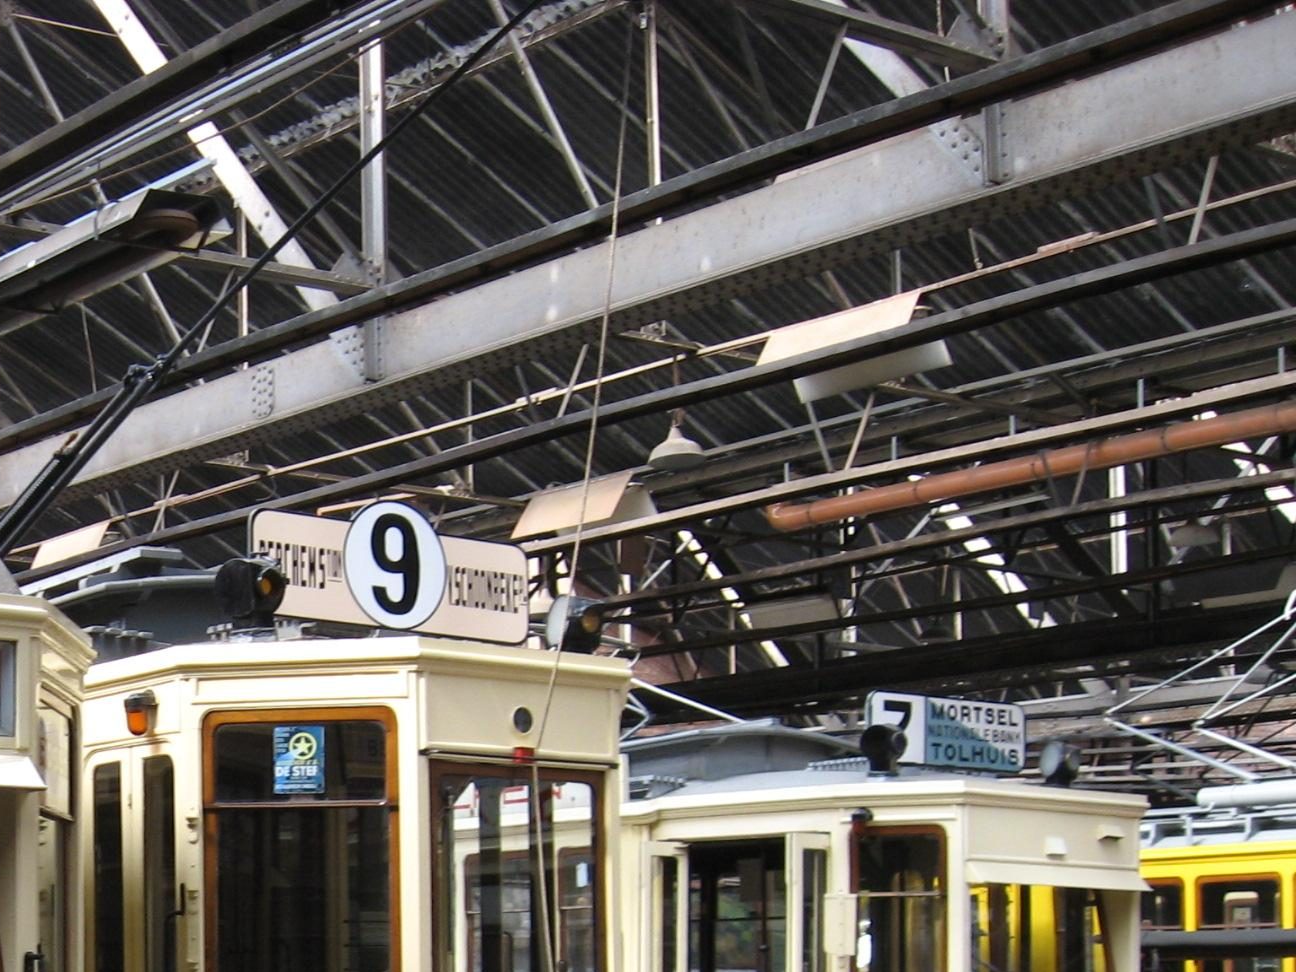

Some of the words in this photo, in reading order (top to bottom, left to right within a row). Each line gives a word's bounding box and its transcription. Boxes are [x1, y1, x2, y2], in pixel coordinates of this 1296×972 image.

[369, 512, 420, 615] 9
[884, 700, 912, 731] 7
[930, 702, 1019, 727] MORTSEL
[931, 742, 1019, 766] TOLHUIS
